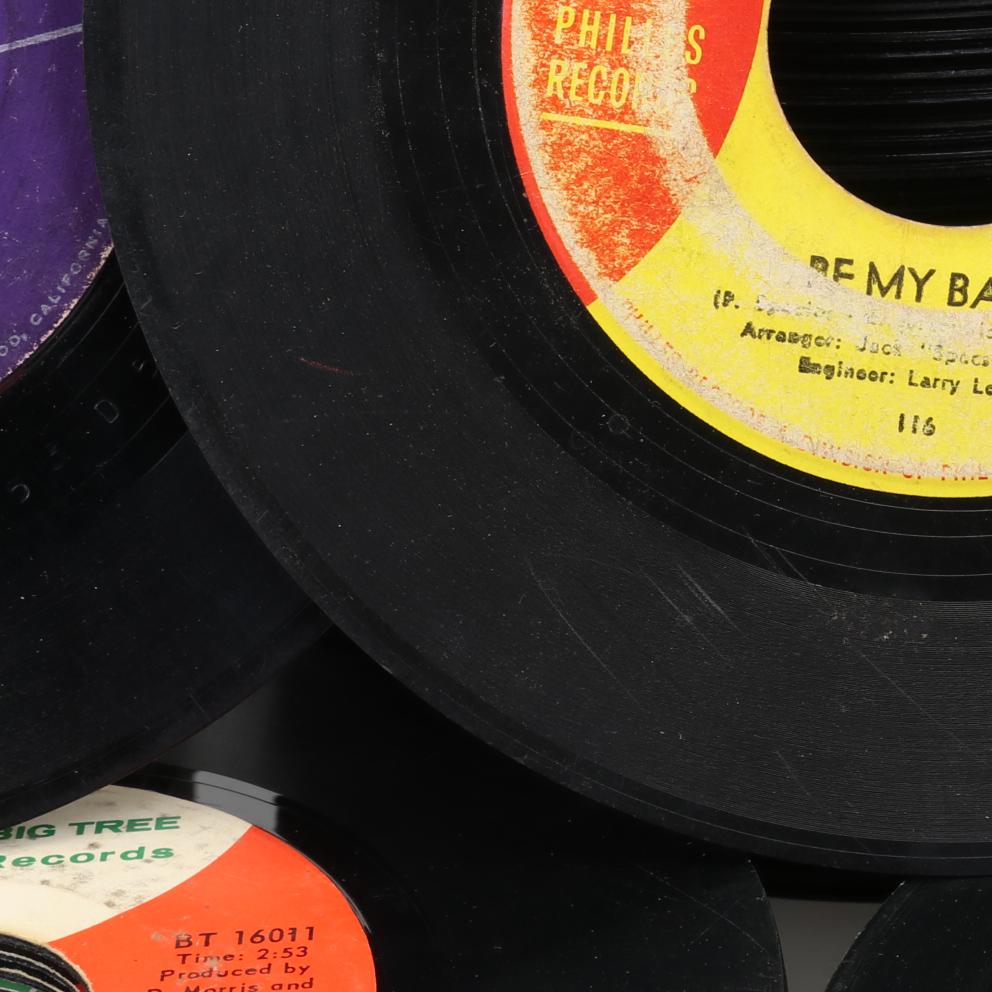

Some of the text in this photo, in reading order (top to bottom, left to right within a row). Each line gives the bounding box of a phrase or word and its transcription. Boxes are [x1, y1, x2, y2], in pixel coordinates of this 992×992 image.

[555, 6, 706, 65] PHILS
[546, 58, 697, 110] RECO
[866, 261, 937, 304] MY
[740, 321, 842, 349] Arranger:
[798, 356, 895, 385] Engineer:
[907, 369, 961, 396] Larry
[897, 412, 937, 437] 116
[68, 815, 182, 836] TREE
[174, 926, 315, 950] BT 16011
[176, 945, 309, 966] Time: 2:53
[159, 962, 311, 983] Produced by
[271, 977, 314, 992] and
